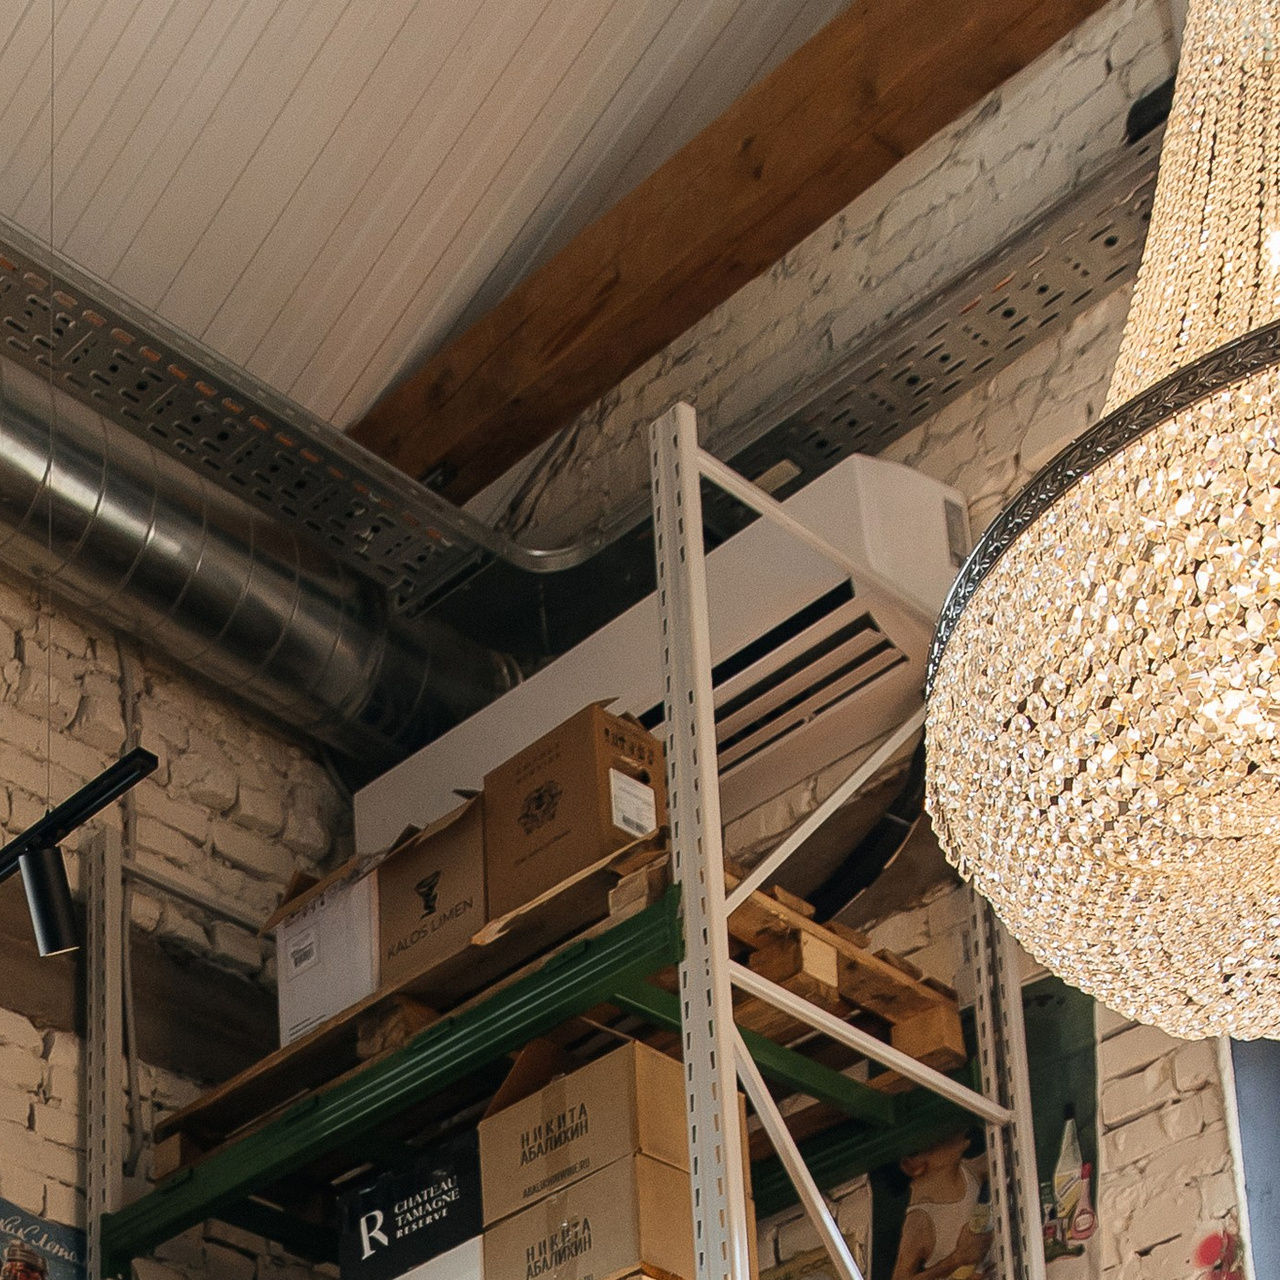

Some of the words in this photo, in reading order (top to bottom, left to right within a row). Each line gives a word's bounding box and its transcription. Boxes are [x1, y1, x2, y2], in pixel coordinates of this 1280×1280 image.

[387, 927, 427, 960] KALOS
[431, 899, 474, 932] LIMEN
[520, 1118, 589, 1166] АБАЛИХИН
[521, 1102, 588, 1148] НИКИТА
[394, 1175, 458, 1213] CHATEAU
[395, 1188, 460, 1227] TAMAGNE
[360, 1209, 389, 1261] R
[396, 1208, 449, 1239] RESERVE
[526, 1217, 592, 1264] НИКИТА
[526, 1233, 592, 1280] АБАЛИХИН
